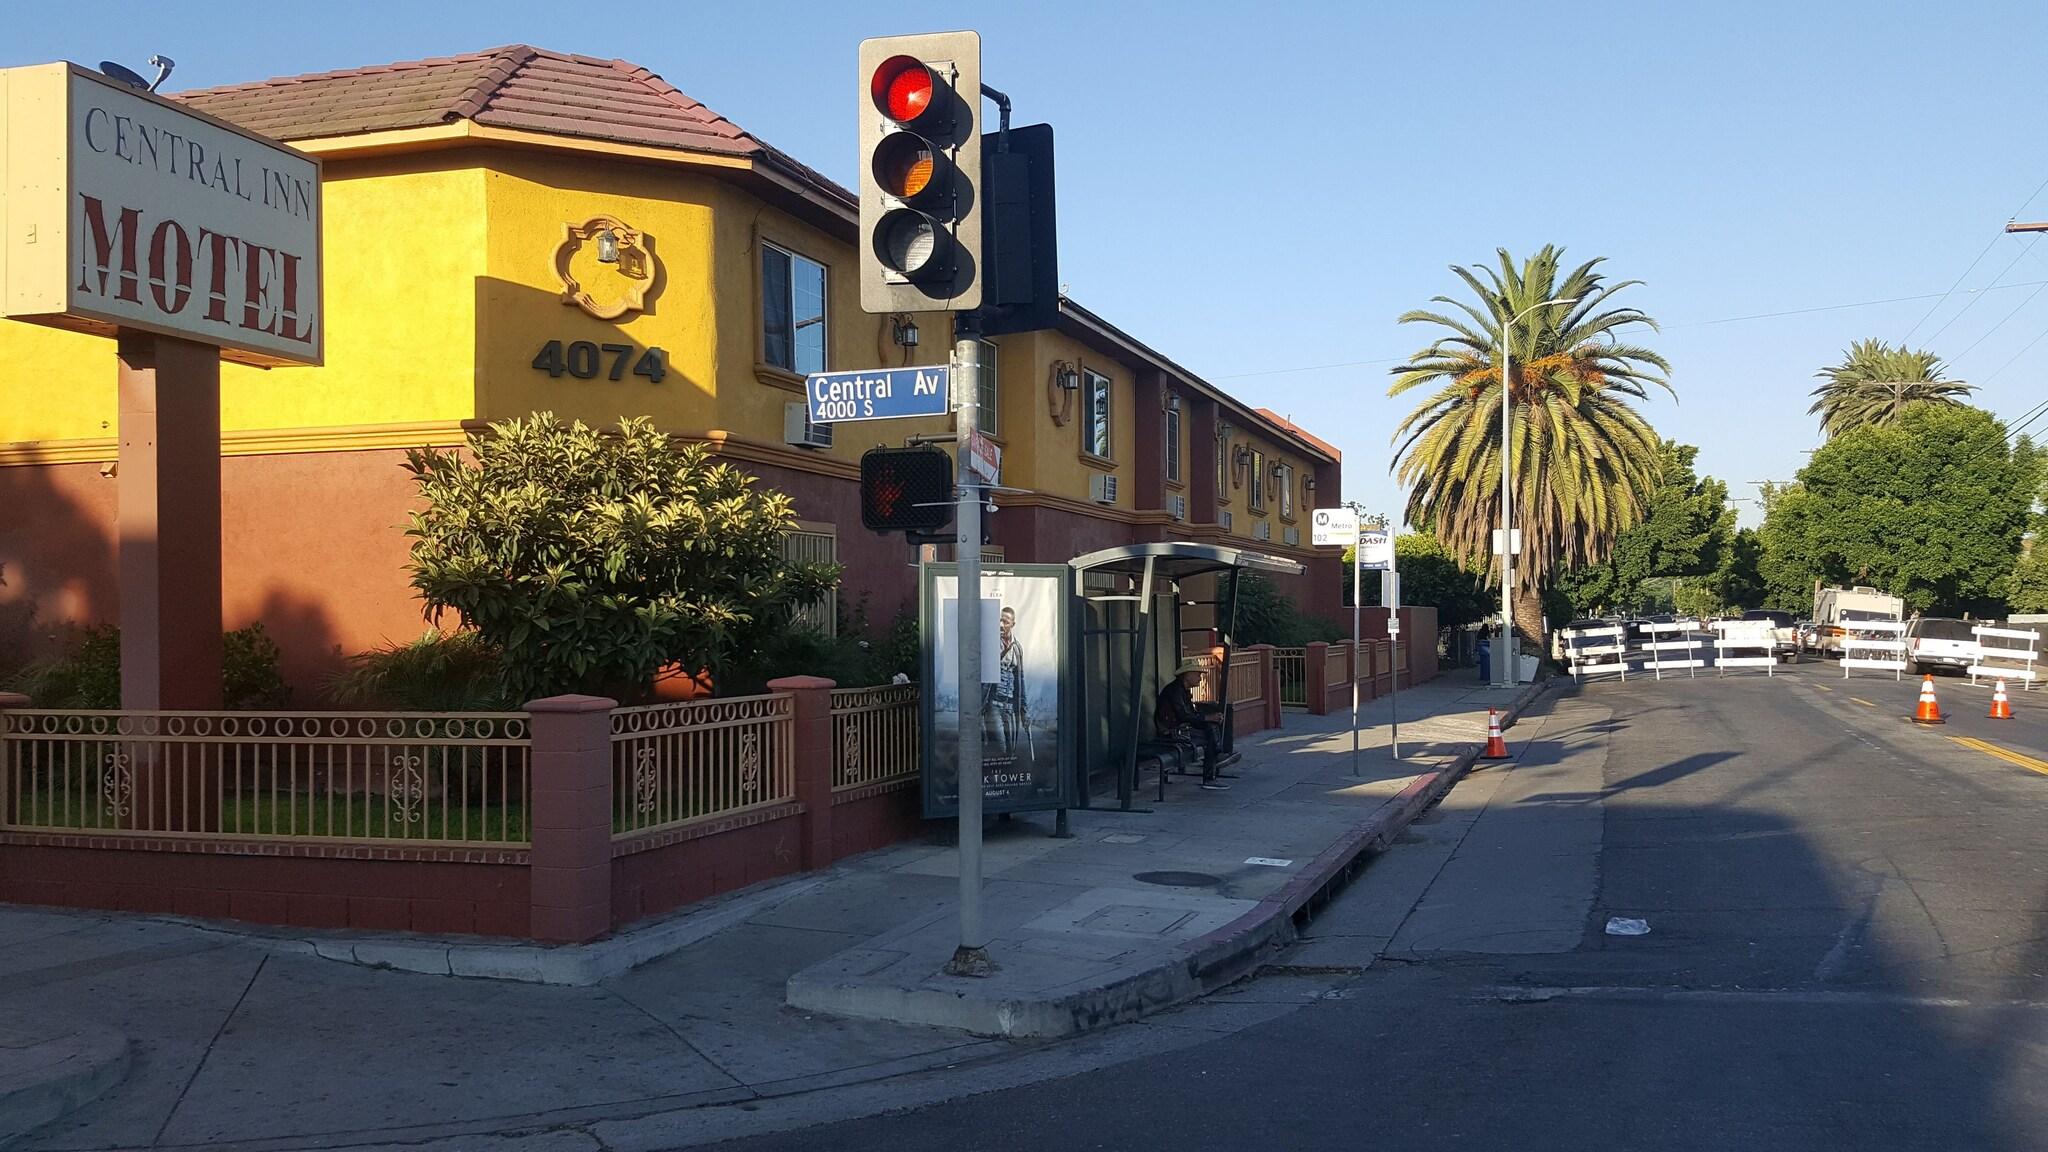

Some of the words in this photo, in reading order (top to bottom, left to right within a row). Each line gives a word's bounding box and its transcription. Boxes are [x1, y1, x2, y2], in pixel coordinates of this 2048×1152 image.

[85, 107, 251, 202] CENTRAL
[262, 167, 312, 221] INN
[77, 191, 313, 344] MOTEL
[532, 339, 667, 384] 4074
[815, 373, 892, 403] Central
[913, 370, 939, 396] Av
[816, 400, 857, 419] 4000
[864, 399, 874, 417] S
[1313, 533, 1328, 542] 102
[1360, 537, 1387, 545] DASH
[994, 772, 1032, 783] TOWER
[985, 789, 1005, 797] AUGUST
